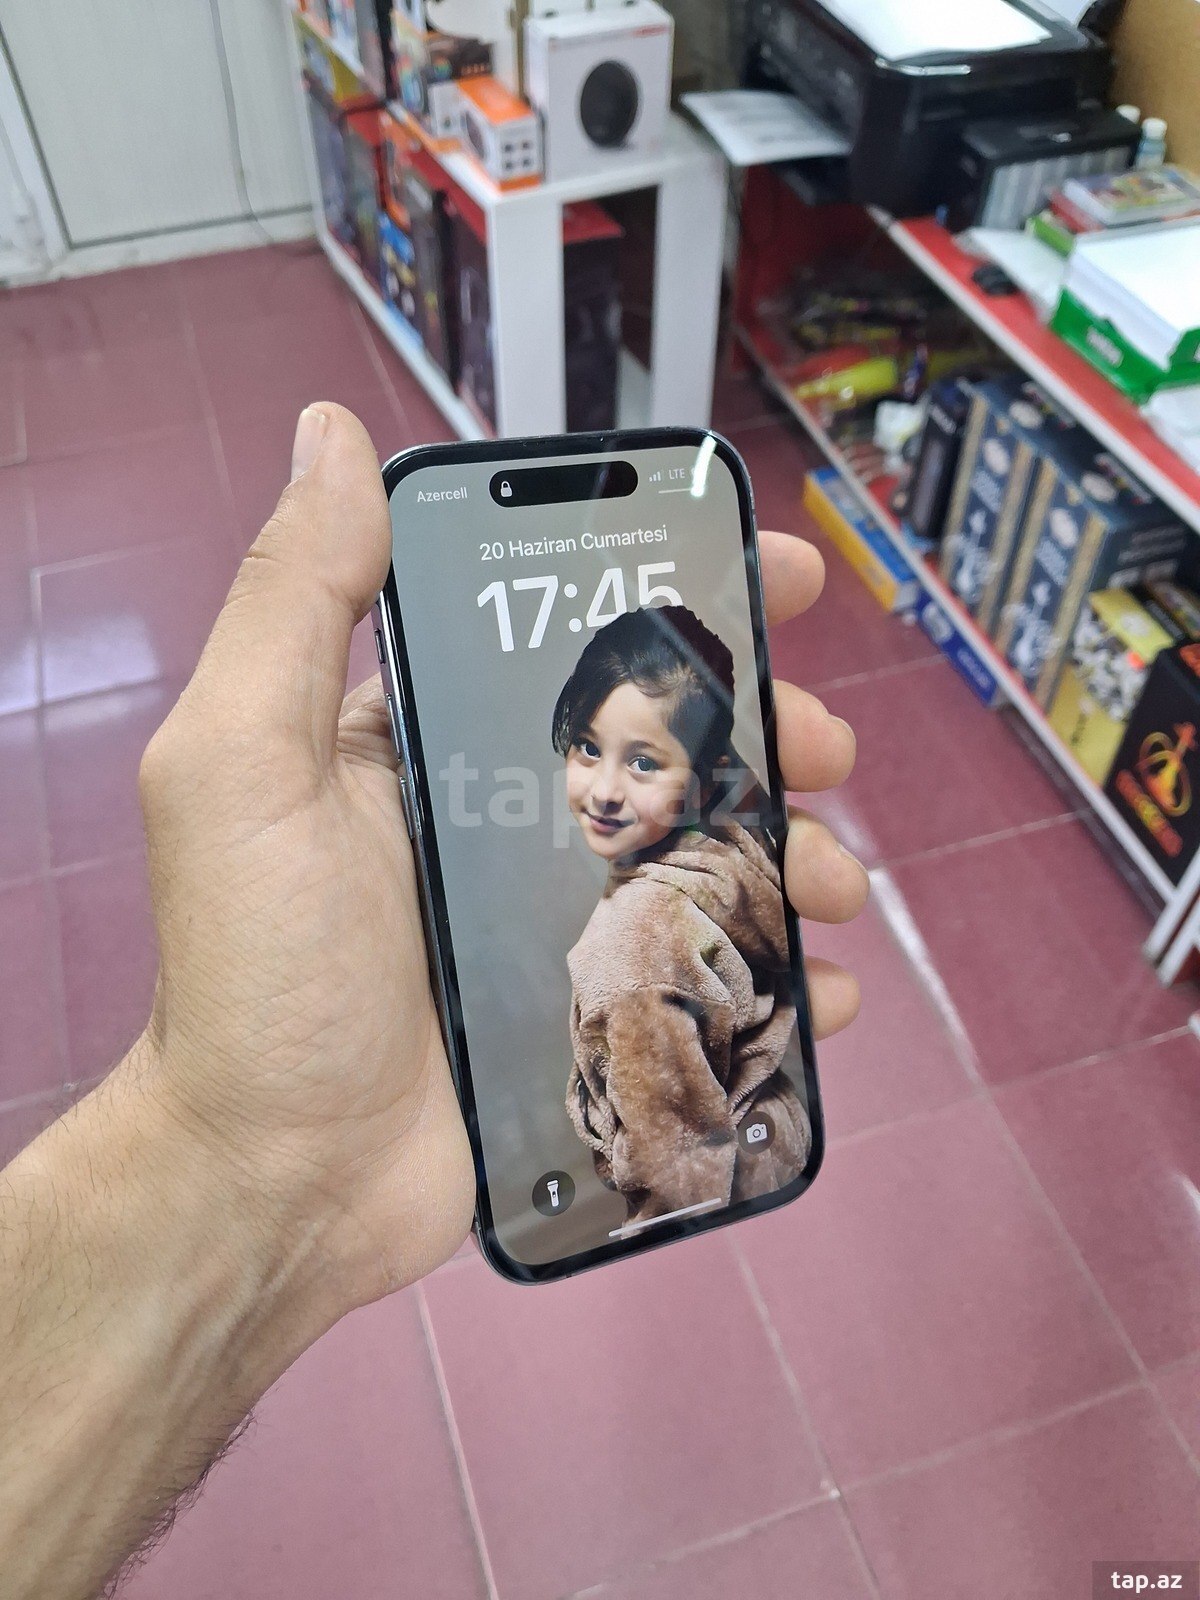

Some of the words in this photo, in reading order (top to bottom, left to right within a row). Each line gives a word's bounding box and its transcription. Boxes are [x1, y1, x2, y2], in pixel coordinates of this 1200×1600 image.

[668, 468, 686, 480] LTE
[416, 486, 468, 503] Azercell
[479, 541, 505, 561] 20
[508, 536, 577, 558] Haziran
[580, 524, 668, 550] Cumartesi
[477, 561, 684, 653] 17:45
